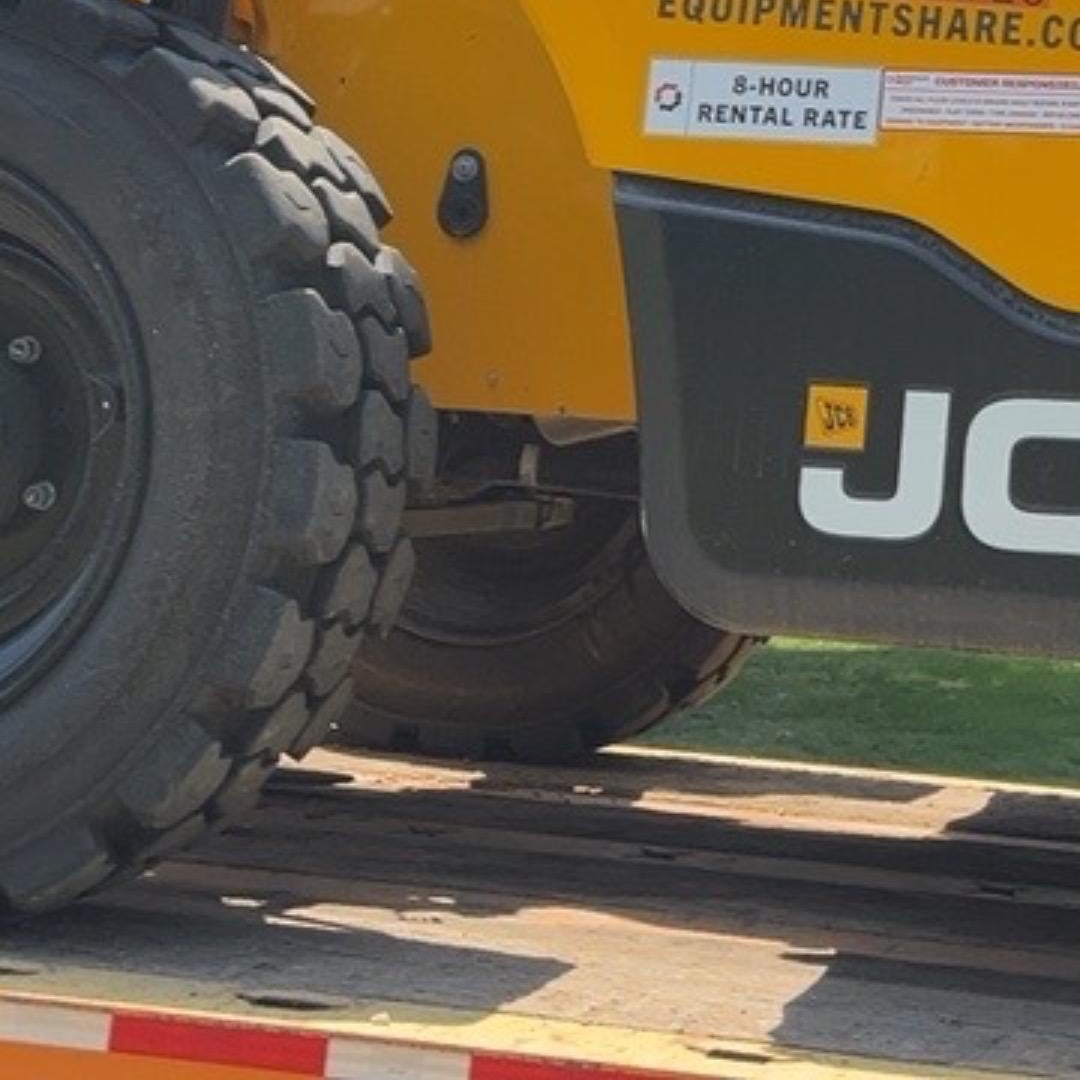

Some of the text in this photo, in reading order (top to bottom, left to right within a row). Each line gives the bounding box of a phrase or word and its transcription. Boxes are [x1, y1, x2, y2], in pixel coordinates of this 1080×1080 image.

[731, 74, 830, 100] 8-HOUR
[696, 103, 868, 131] RENTAL RATE
